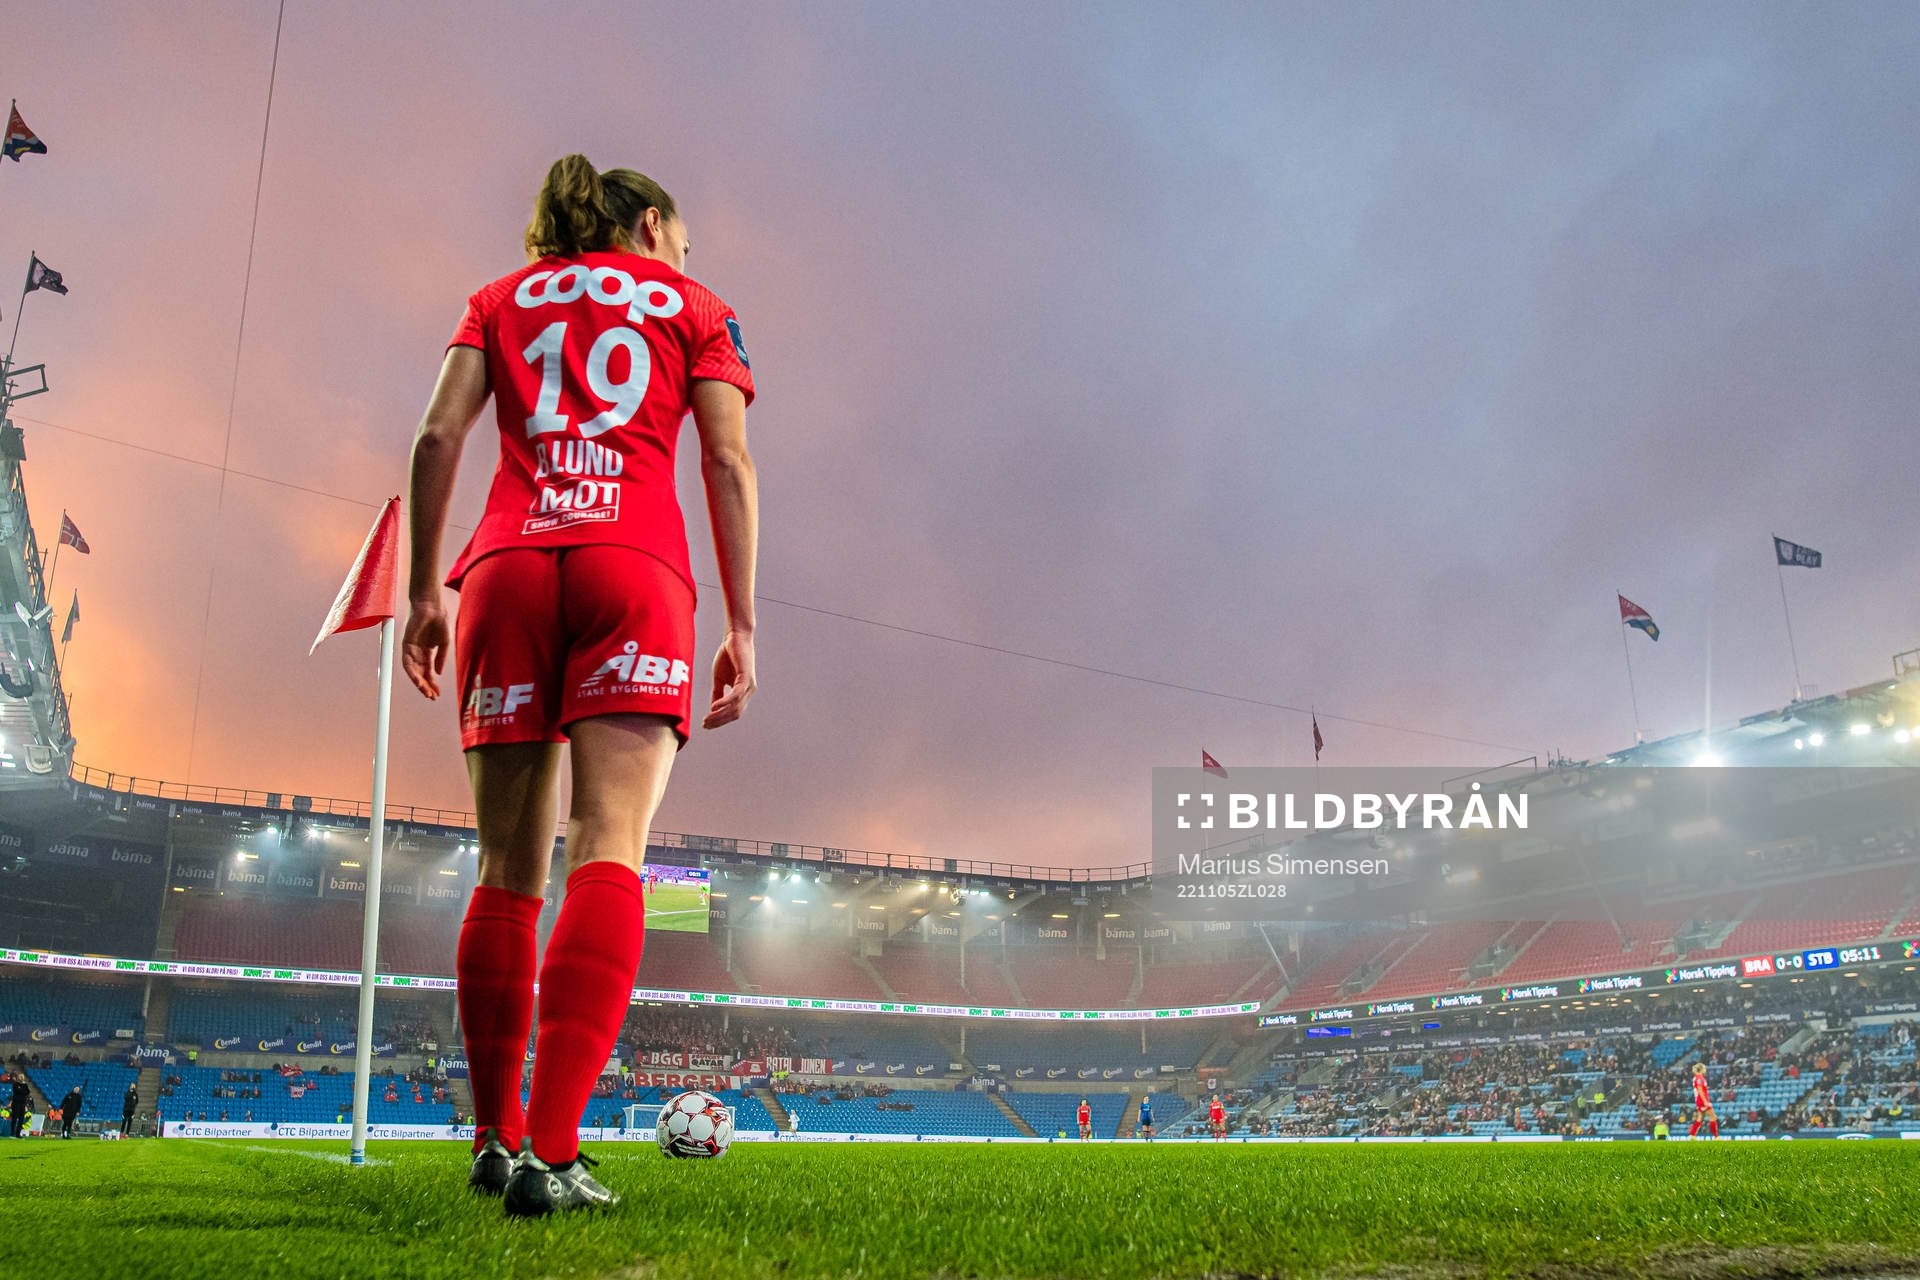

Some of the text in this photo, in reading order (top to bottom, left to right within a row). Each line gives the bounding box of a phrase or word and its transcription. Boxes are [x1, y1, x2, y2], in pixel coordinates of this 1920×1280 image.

[514, 264, 684, 325] coop
[522, 321, 651, 438] 19
[541, 480, 619, 512] MOT
[530, 511, 611, 529] SHOW COURAGE!
[611, 685, 679, 697] BYGGMESTER
[112, 848, 152, 864] bama
[228, 869, 265, 884] bama
[330, 877, 366, 892] bama
[1038, 927, 1068, 938] bama
[1105, 928, 1135, 939] bama
[1744, 961, 1771, 973] BRA
[1807, 952, 1833, 966] STB
[1840, 947, 1881, 963] 05:11
[1679, 964, 1736, 980] Norsk Tipping
[1591, 976, 1642, 990] Norsk Tipping
[1512, 986, 1558, 998] Norsk Tipping
[1377, 1002, 1414, 1013] Norsk Tipping
[1442, 994, 1482, 1007] Norsk Tipping
[135, 1045, 170, 1058] bama
[651, 1052, 682, 1066] BGG
[691, 1058, 724, 1067] QATAR
[634, 1071, 732, 1090] BERGEN
[185, 1126, 252, 1139] CTC Bilpartner
[278, 1126, 350, 1139] CTC Bilpartner
[374, 1128, 435, 1140] CTC Bilpartner
